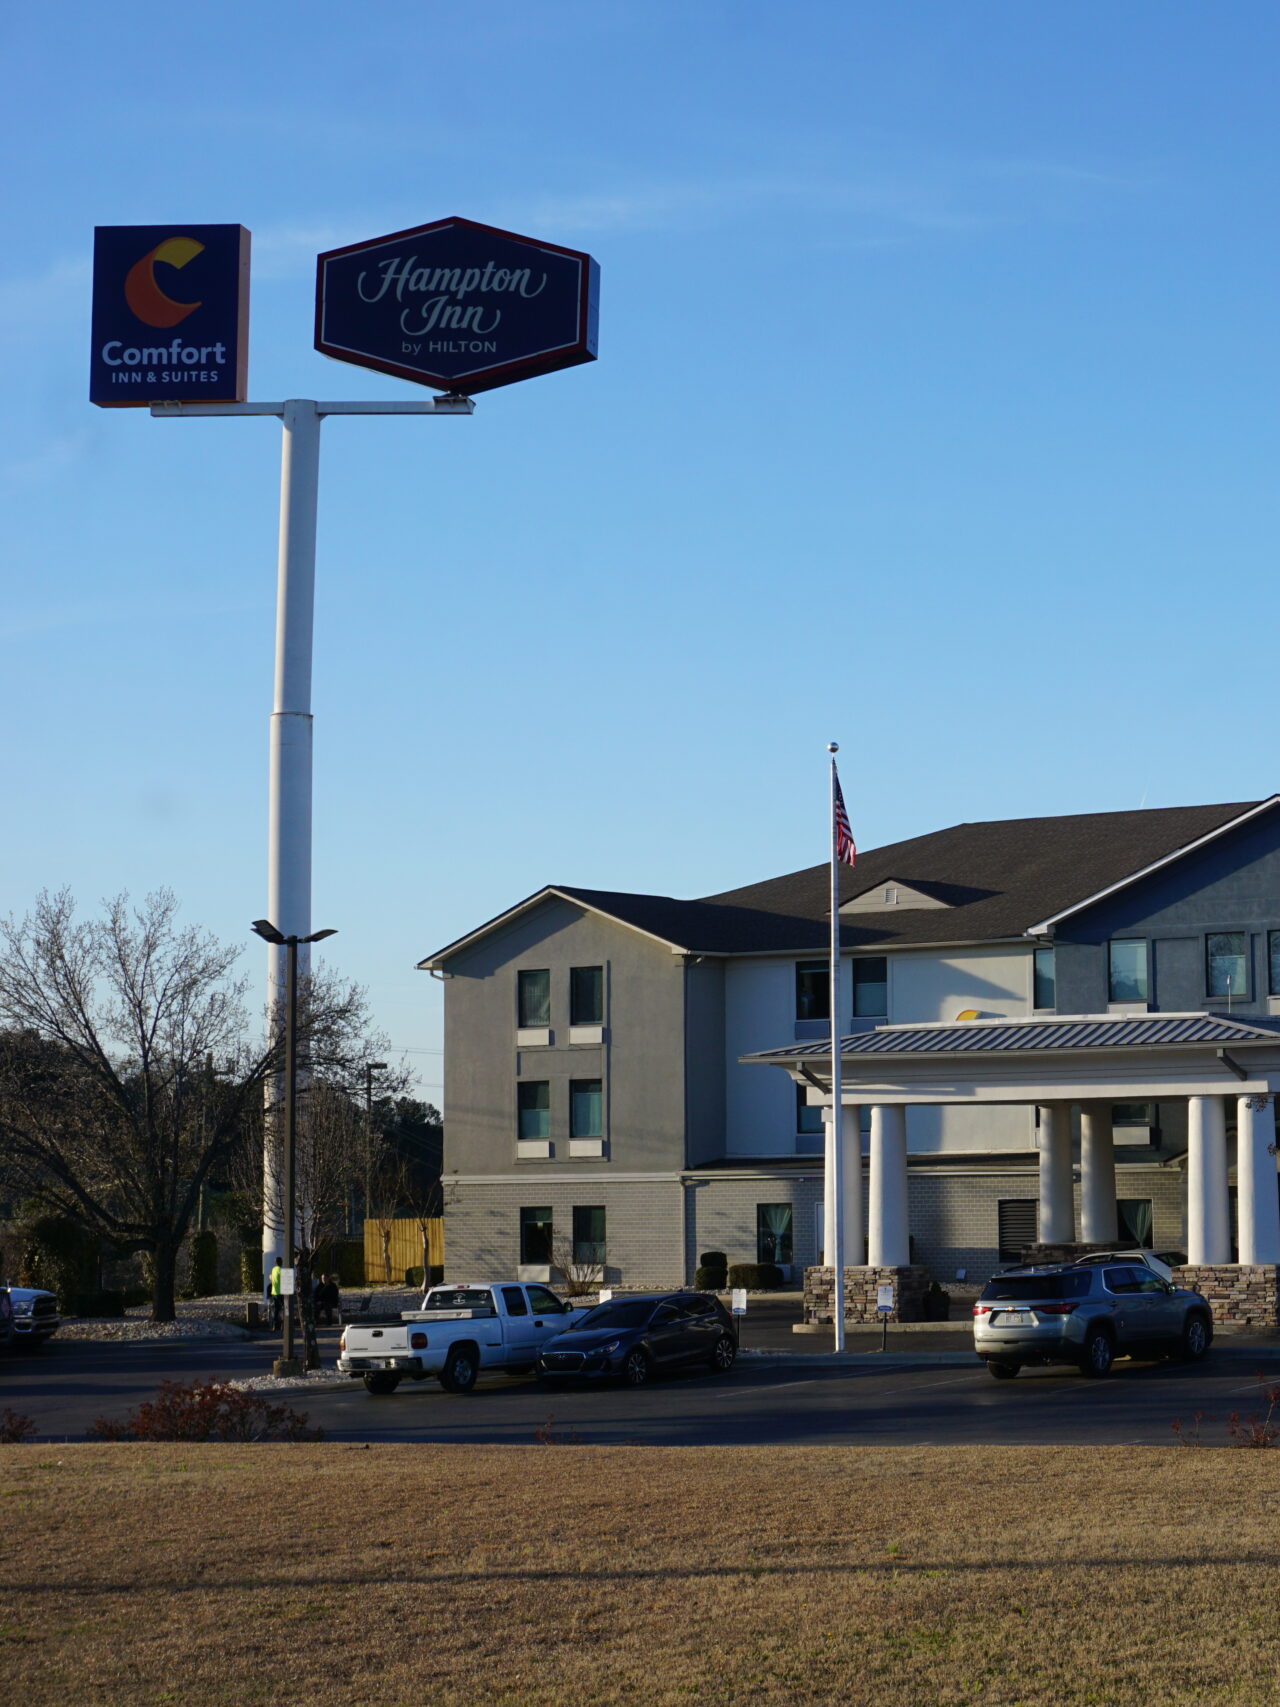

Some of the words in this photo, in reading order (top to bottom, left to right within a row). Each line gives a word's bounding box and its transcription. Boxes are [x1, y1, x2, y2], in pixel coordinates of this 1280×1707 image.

[357, 255, 547, 303] Hampton
[400, 294, 501, 336] Inn
[102, 339, 226, 366] Comfort
[401, 340, 422, 356] by
[429, 340, 497, 353] HILTON
[112, 372, 142, 383] INN
[146, 371, 157, 382] &
[161, 371, 218, 382] SUITES
